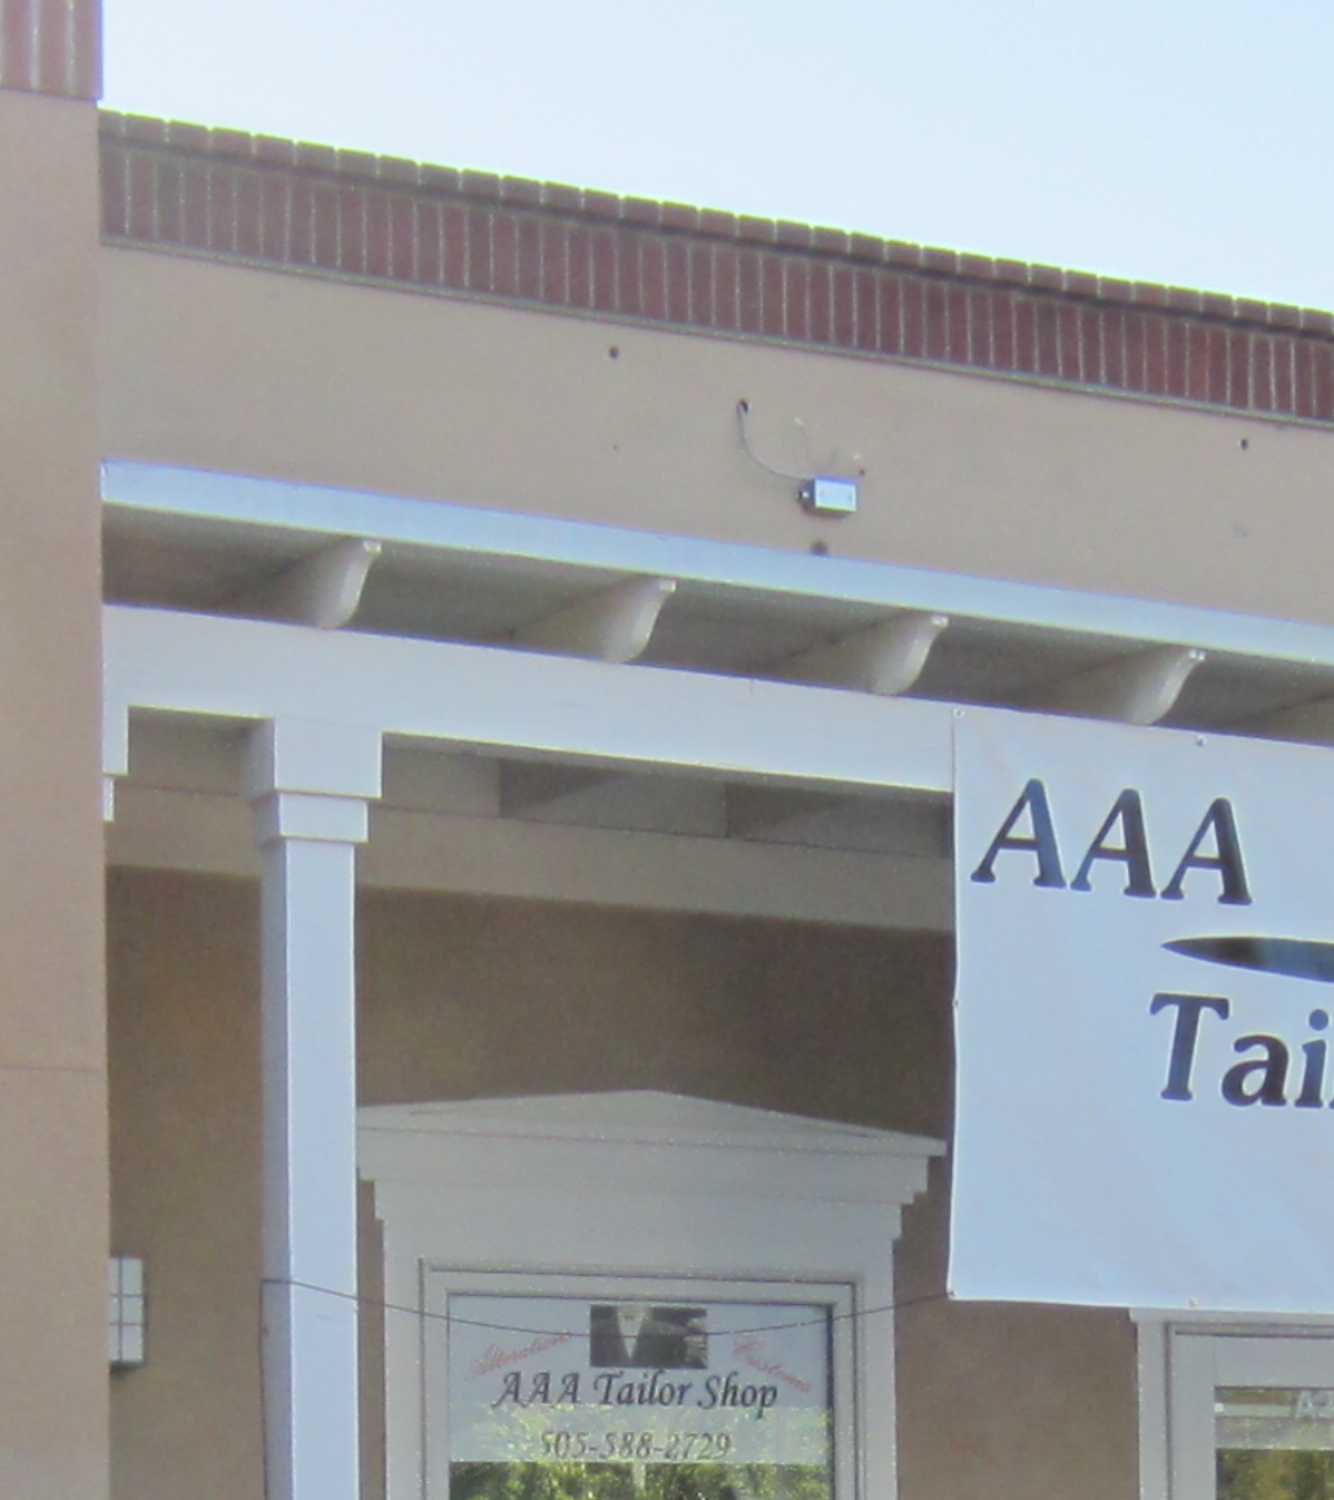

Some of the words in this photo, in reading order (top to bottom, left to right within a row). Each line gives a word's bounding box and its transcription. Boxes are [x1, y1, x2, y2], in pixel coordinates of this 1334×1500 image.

[971, 778, 1253, 906] AAA
[491, 1370, 581, 1408] AAA
[593, 1369, 691, 1407] Tailor
[697, 1371, 778, 1418] Shop
[539, 1431, 731, 1460] 505-588-2729
